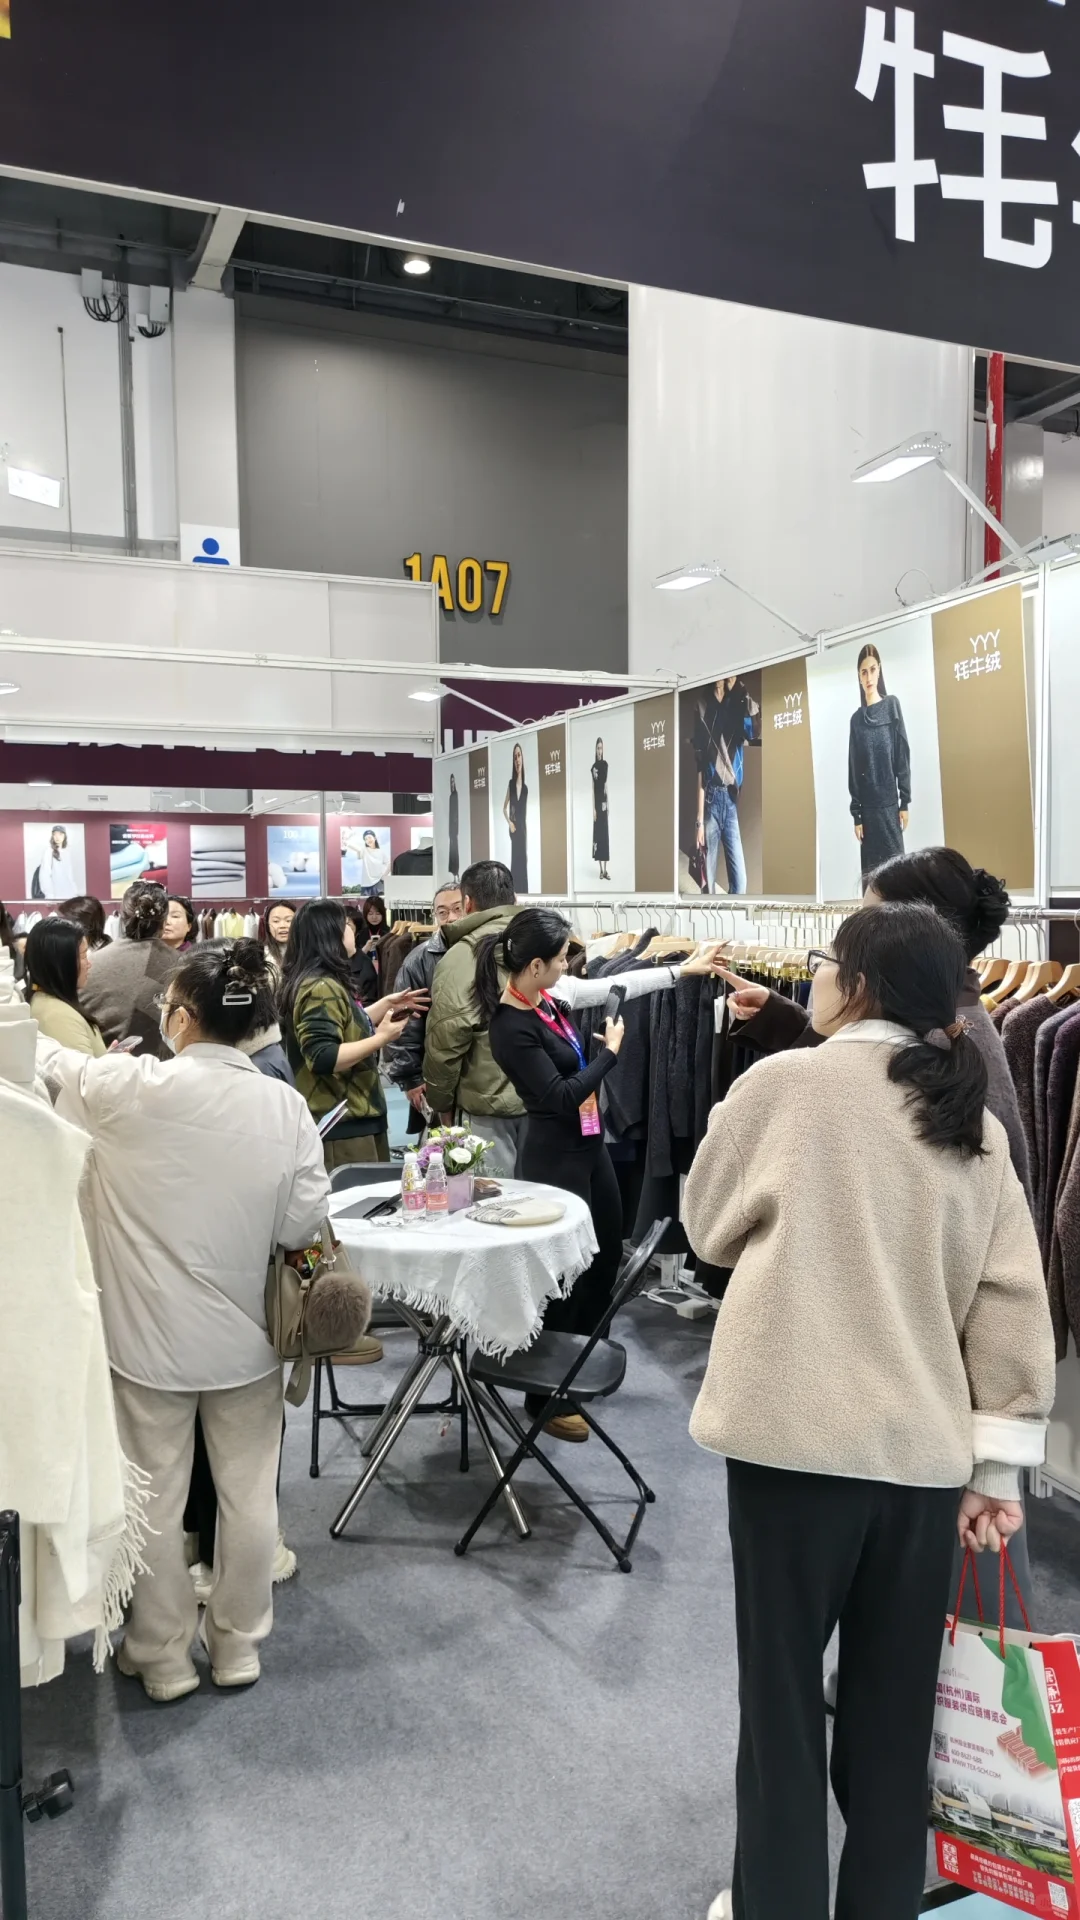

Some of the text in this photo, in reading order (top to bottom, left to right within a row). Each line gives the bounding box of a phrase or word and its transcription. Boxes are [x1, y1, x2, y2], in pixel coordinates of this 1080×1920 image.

[855, 5, 1080, 269] 牦
[404, 552, 510, 615] 1A07
[970, 628, 1001, 654] YYY
[953, 650, 1002, 682] 牦牛绒
[783, 691, 803, 709] YYY
[773, 708, 803, 730] 牦牛绒
[643, 734, 666, 751] 牦牛绒
